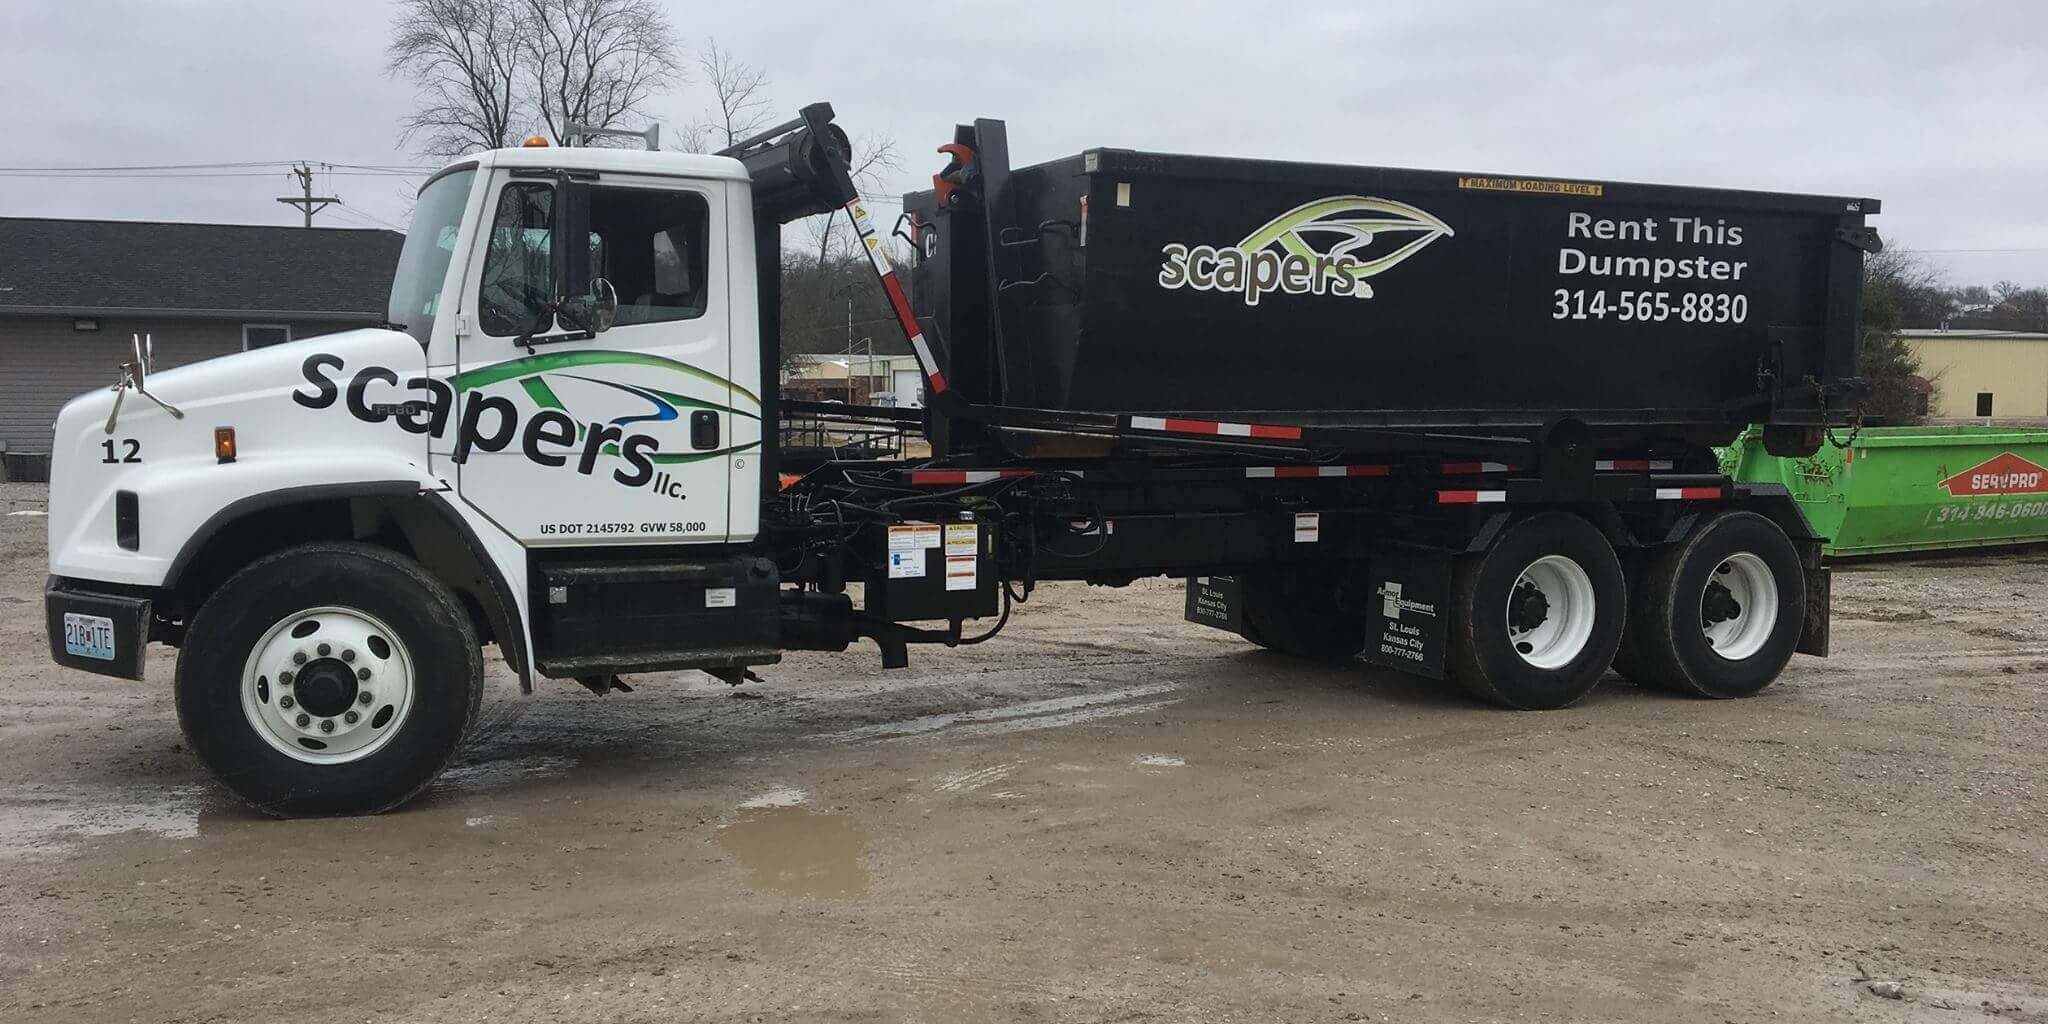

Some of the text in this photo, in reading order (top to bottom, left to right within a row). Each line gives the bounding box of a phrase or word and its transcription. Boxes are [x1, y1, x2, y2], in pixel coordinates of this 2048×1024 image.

[1521, 181, 1561, 192] LOADING
[1564, 184, 1591, 194] LEVEL
[1567, 211, 1744, 246] Rent This
[1159, 243, 1357, 305] scapers
[1558, 248, 1748, 284] Dumpster
[1552, 288, 1749, 324] 314-565-8830
[292, 352, 687, 500] scapers llc.
[101, 438, 143, 464] 12
[1971, 472, 2038, 490] SERVPRO
[540, 521, 706, 535] US DOT 2145792 GVW 58,000
[1383, 632, 1424, 651] Kansas City
[1400, 623, 1420, 636] Louis
